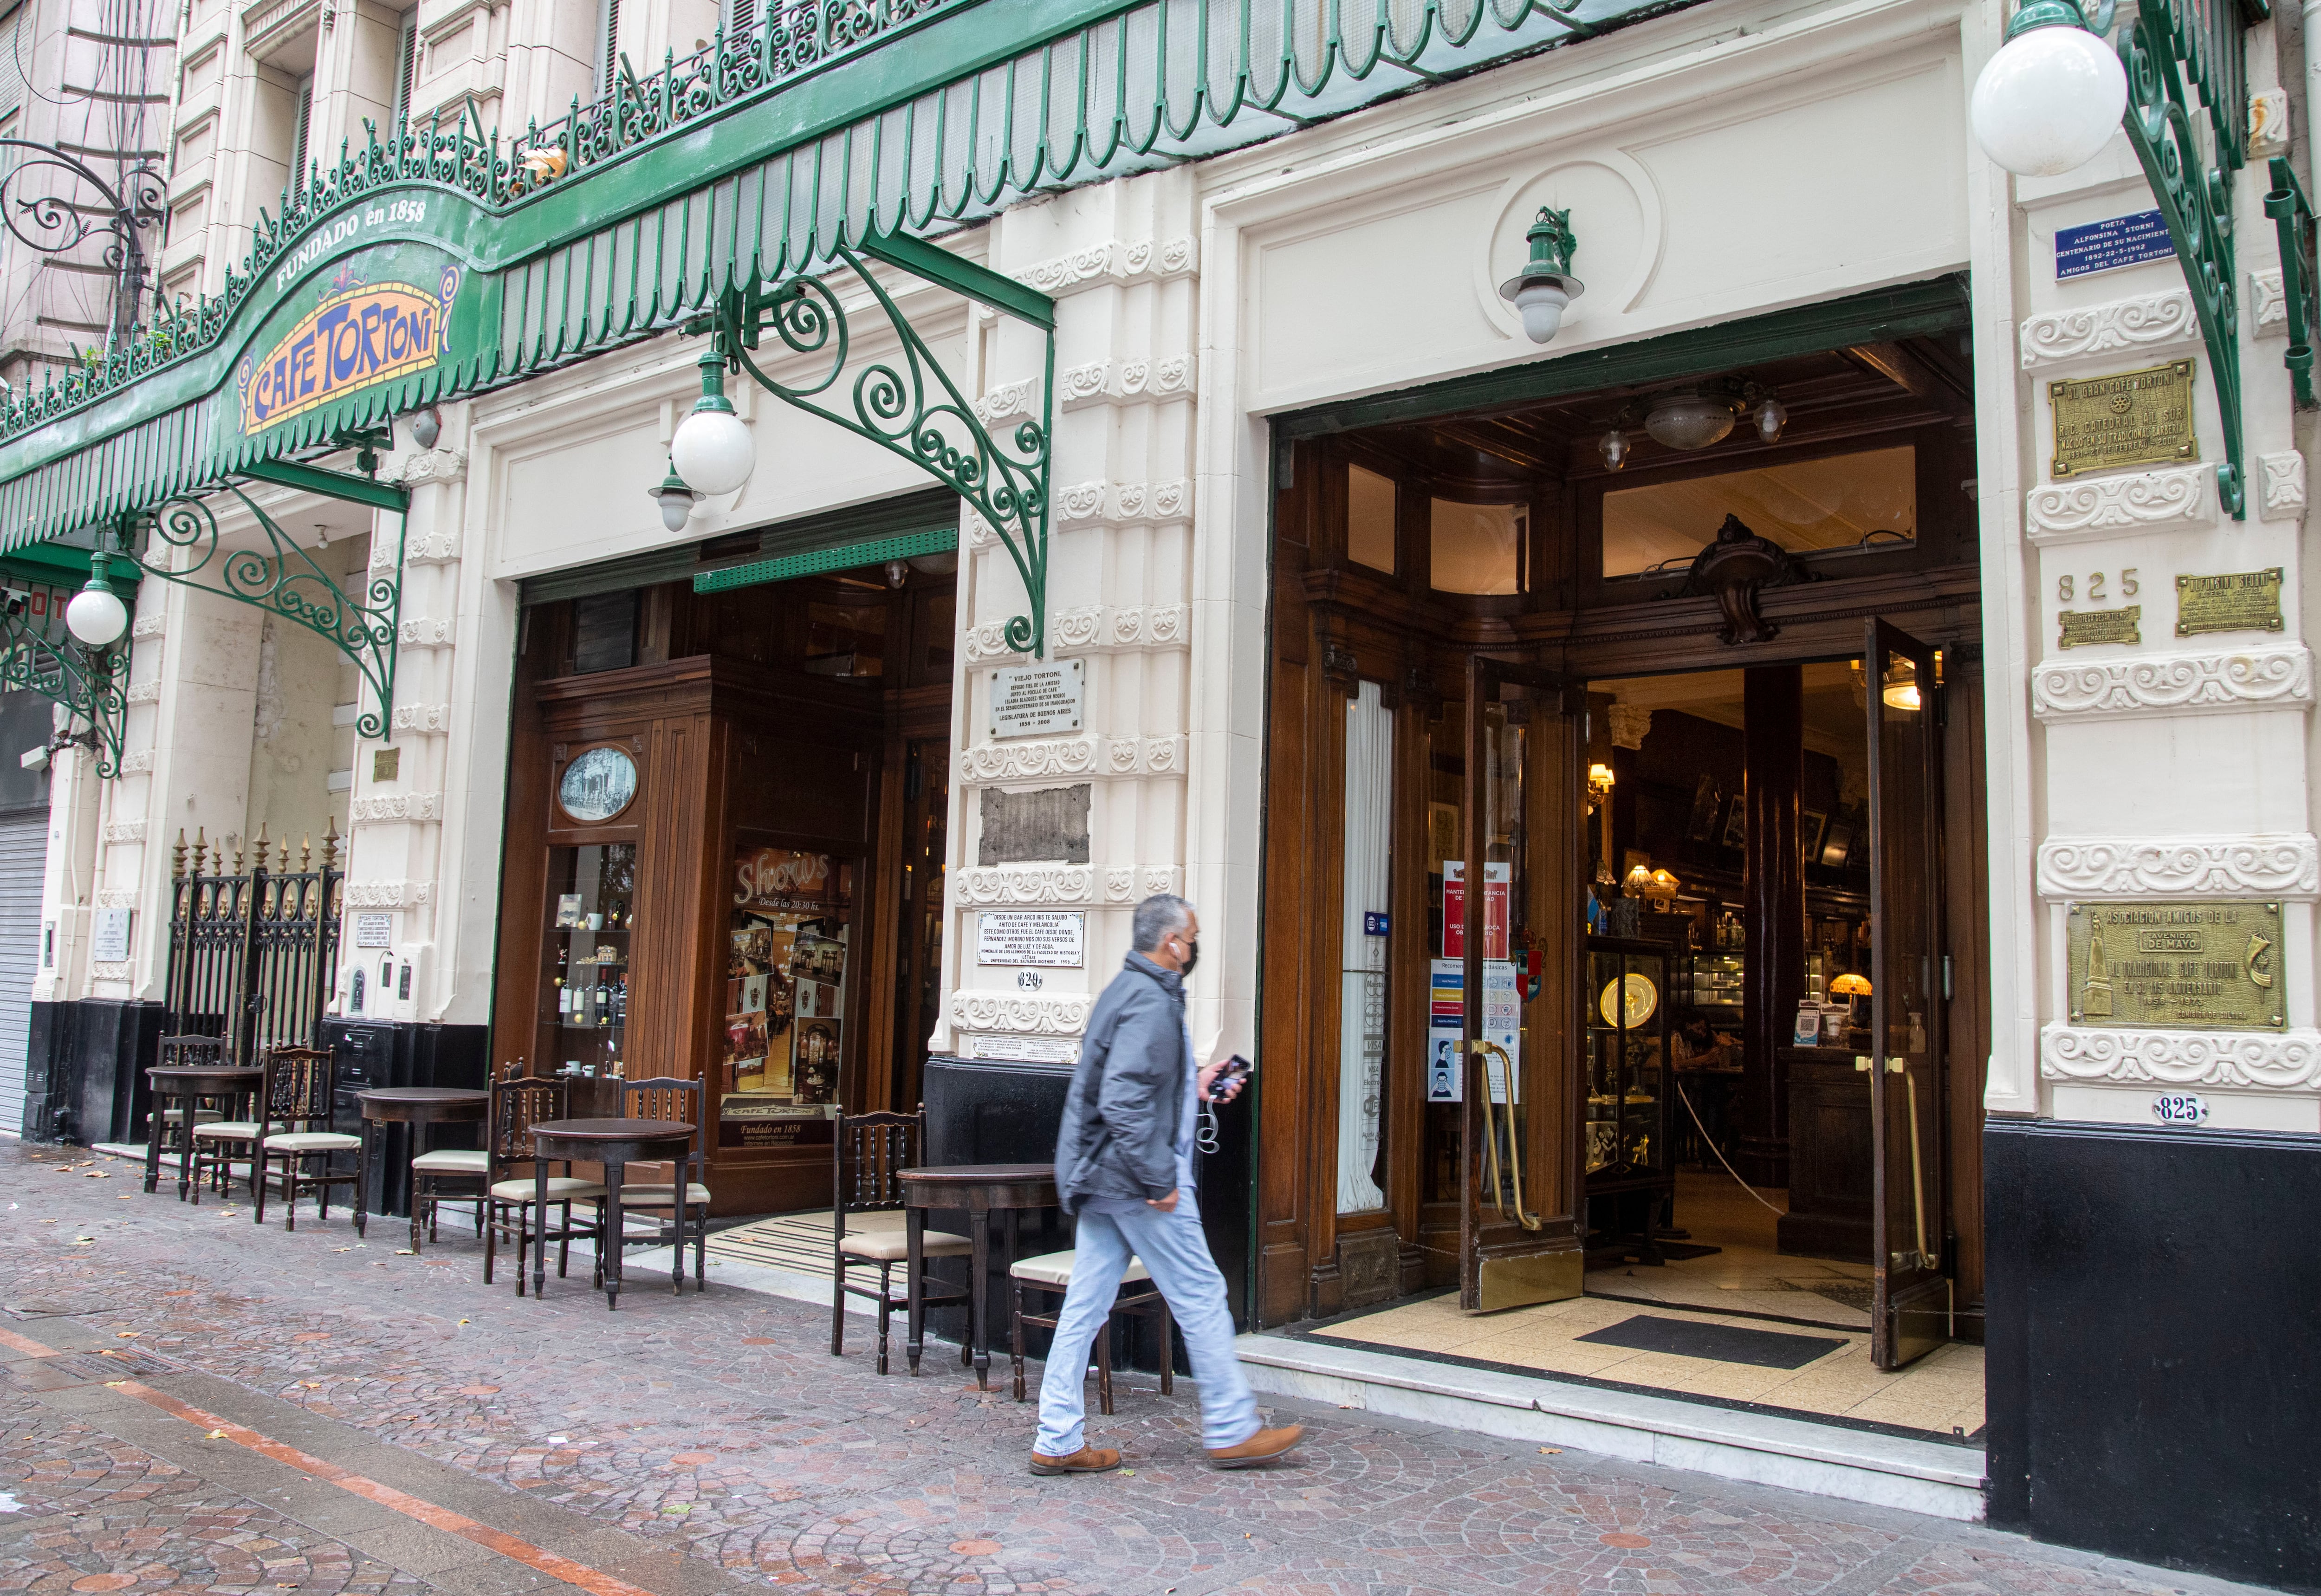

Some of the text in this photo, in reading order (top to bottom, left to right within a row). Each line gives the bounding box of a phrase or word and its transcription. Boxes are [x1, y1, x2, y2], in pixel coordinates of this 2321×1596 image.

[2101, 220, 2126, 229] POETA
[2074, 222, 2154, 244] ALFONSINA STORNI
[277, 199, 426, 293] FUNDADO en 1858
[2056, 244, 2101, 258] CENTENARIO
[2085, 244, 2145, 261] 1892-22-5-1992
[2061, 265, 2089, 275] AMIGOS
[2113, 256, 2133, 264] CAFE
[2139, 247, 2172, 259] TORTONI
[254, 303, 431, 421] CAFE TORTONI
[2068, 373, 2173, 400] AL GRAN CAFE TORTONI
[2059, 408, 2182, 436] R. C. CATEDRAL AL SUR
[2098, 423, 2183, 445] SU TRADICIONAL BARBERIA
[2104, 436, 2176, 454] DE FEBRERO 2000
[2191, 577, 2234, 592] ALFONSINA
[2067, 615, 2093, 624] BIBLIOTECA
[1006, 702, 1038, 711] SESQUICENTENARIO
[734, 854, 828, 903] Shows
[759, 897, 779, 906] Desde
[781, 899, 790, 908] las
[791, 901, 810, 909] 20:30
[2107, 911, 2237, 924] ASOCIACION AMIGOS DE LA
[2149, 940, 2197, 949] DE MAYO
[2111, 961, 2237, 978] AL TRADICIONAL CAFE TORTONI
[1020, 972, 1038, 986] 829
[2124, 982, 2222, 995] EN SU 115 ANIVERSARIO
[1368, 1041, 1381, 1050] VISA
[2160, 1097, 2198, 1120] 825
[740, 1124, 772, 1134] Fundado
[784, 1125, 801, 1133] 1858
